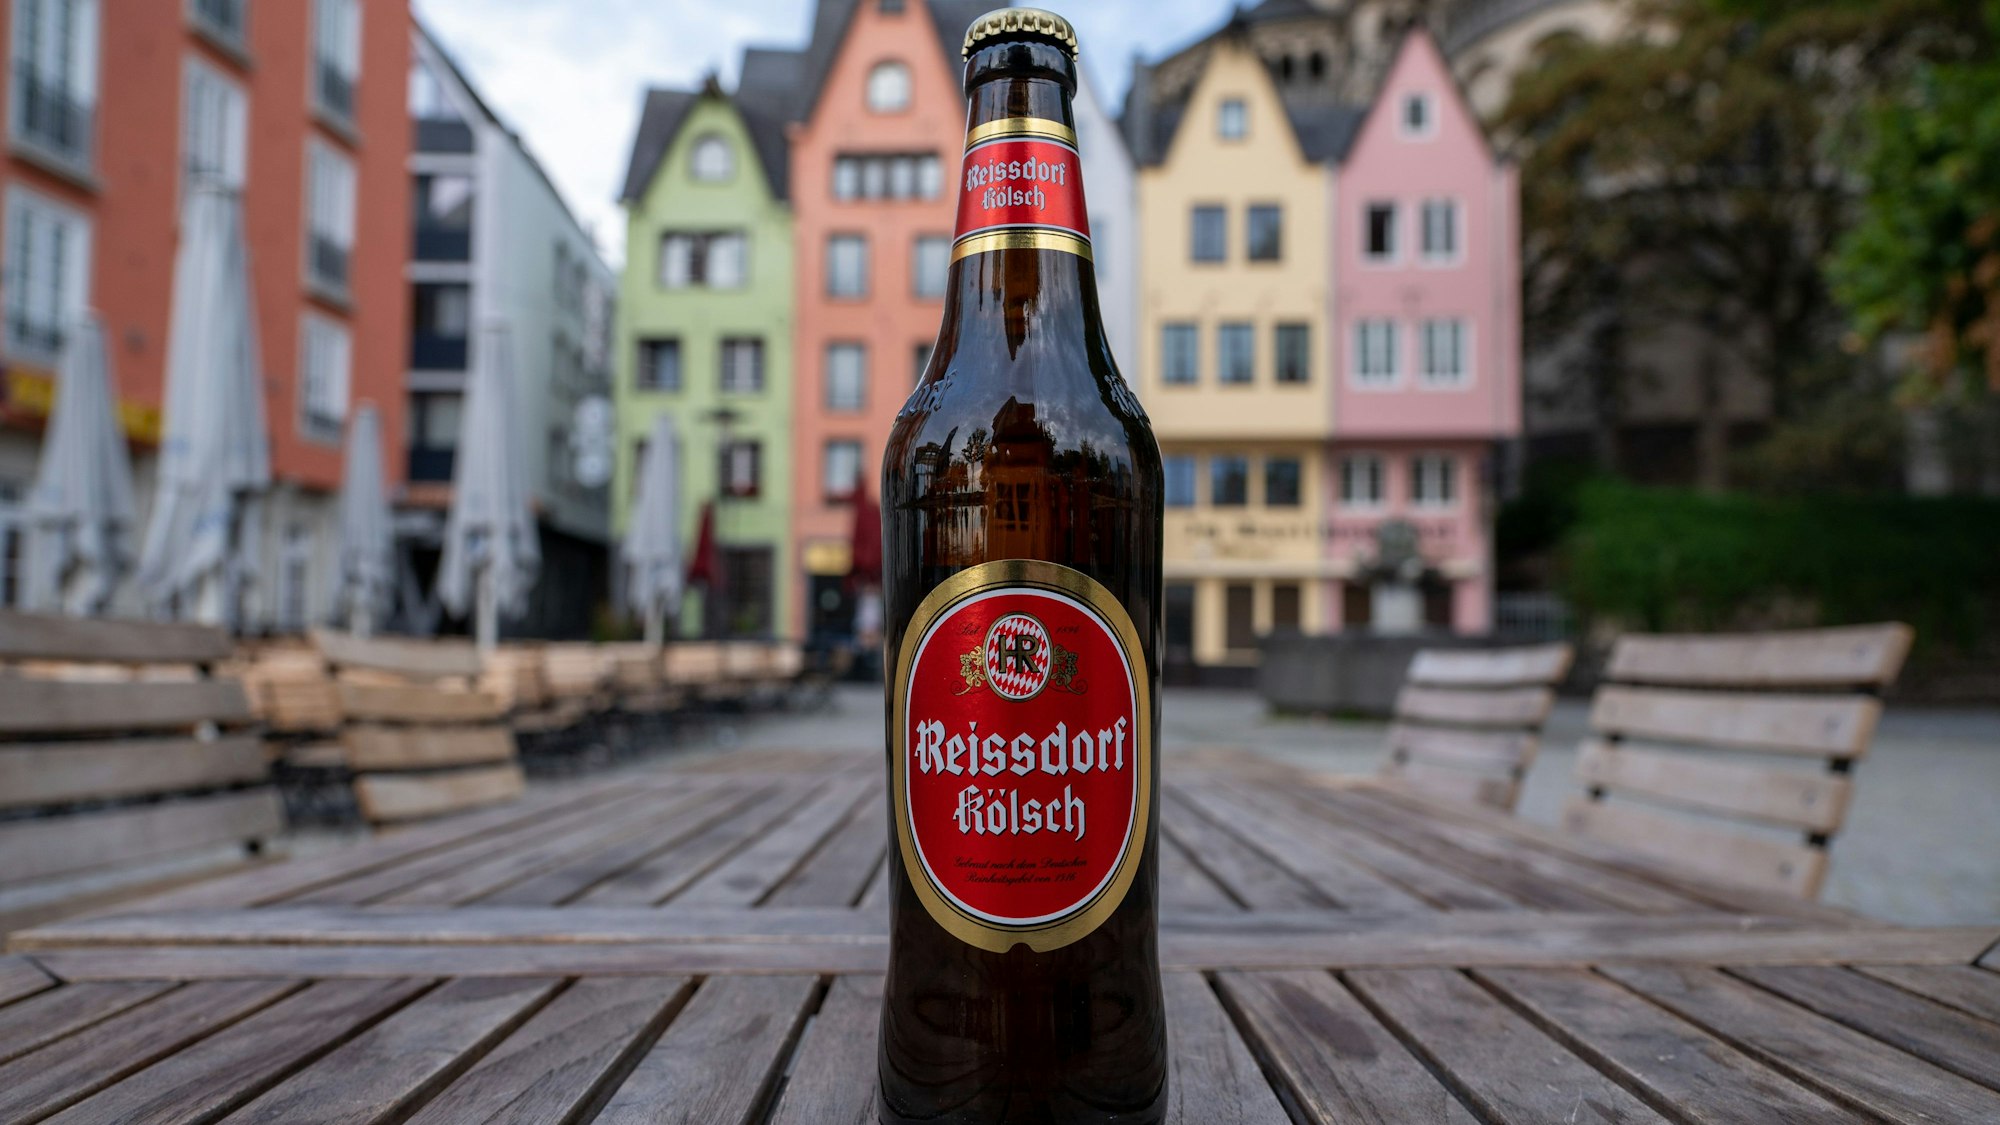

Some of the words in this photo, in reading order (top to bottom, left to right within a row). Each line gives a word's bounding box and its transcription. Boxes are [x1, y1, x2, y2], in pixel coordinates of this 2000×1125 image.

[966, 156, 1066, 192] Reissdorf
[982, 184, 1045, 211] Kölsch
[998, 634, 1041, 674] HR
[914, 715, 1127, 777] Reissdorf
[952, 783, 1086, 841] Kölsch
